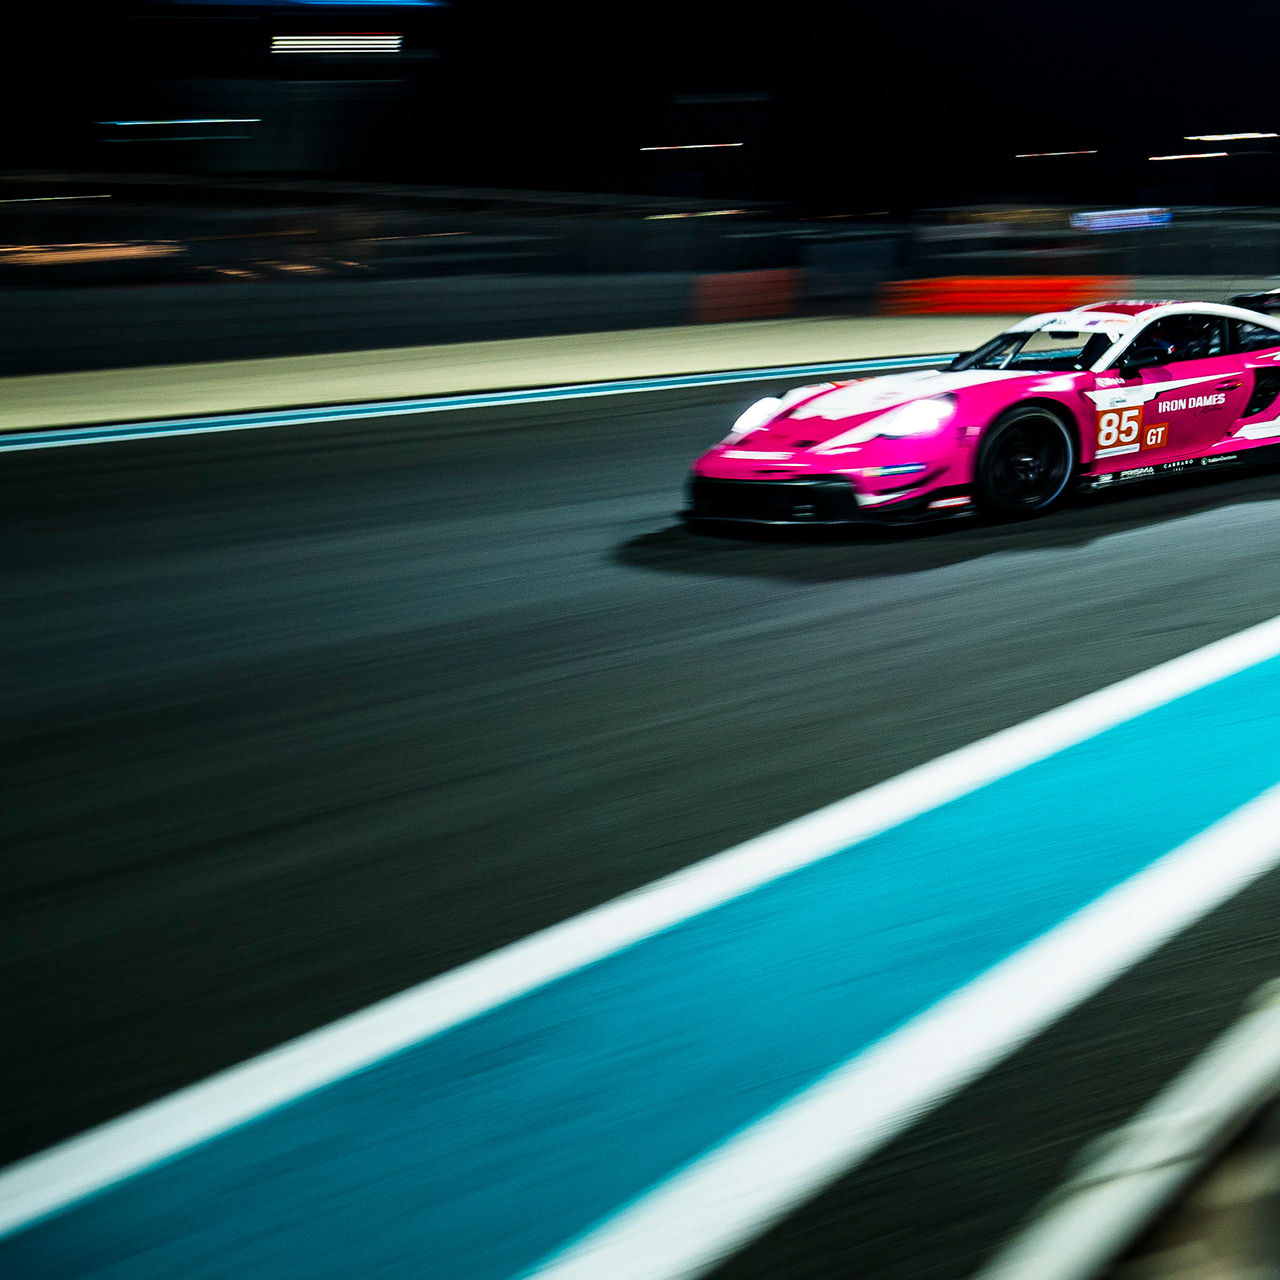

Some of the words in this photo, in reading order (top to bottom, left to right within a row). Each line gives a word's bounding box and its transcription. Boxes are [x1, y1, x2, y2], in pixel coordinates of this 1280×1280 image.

[1158, 399, 1186, 413] IRON
[1188, 393, 1226, 409] DAMES
[1097, 409, 1139, 447] 85
[1146, 427, 1166, 446] GT
[1120, 466, 1154, 478] PRISMA
[1163, 459, 1194, 469] CARRARO
